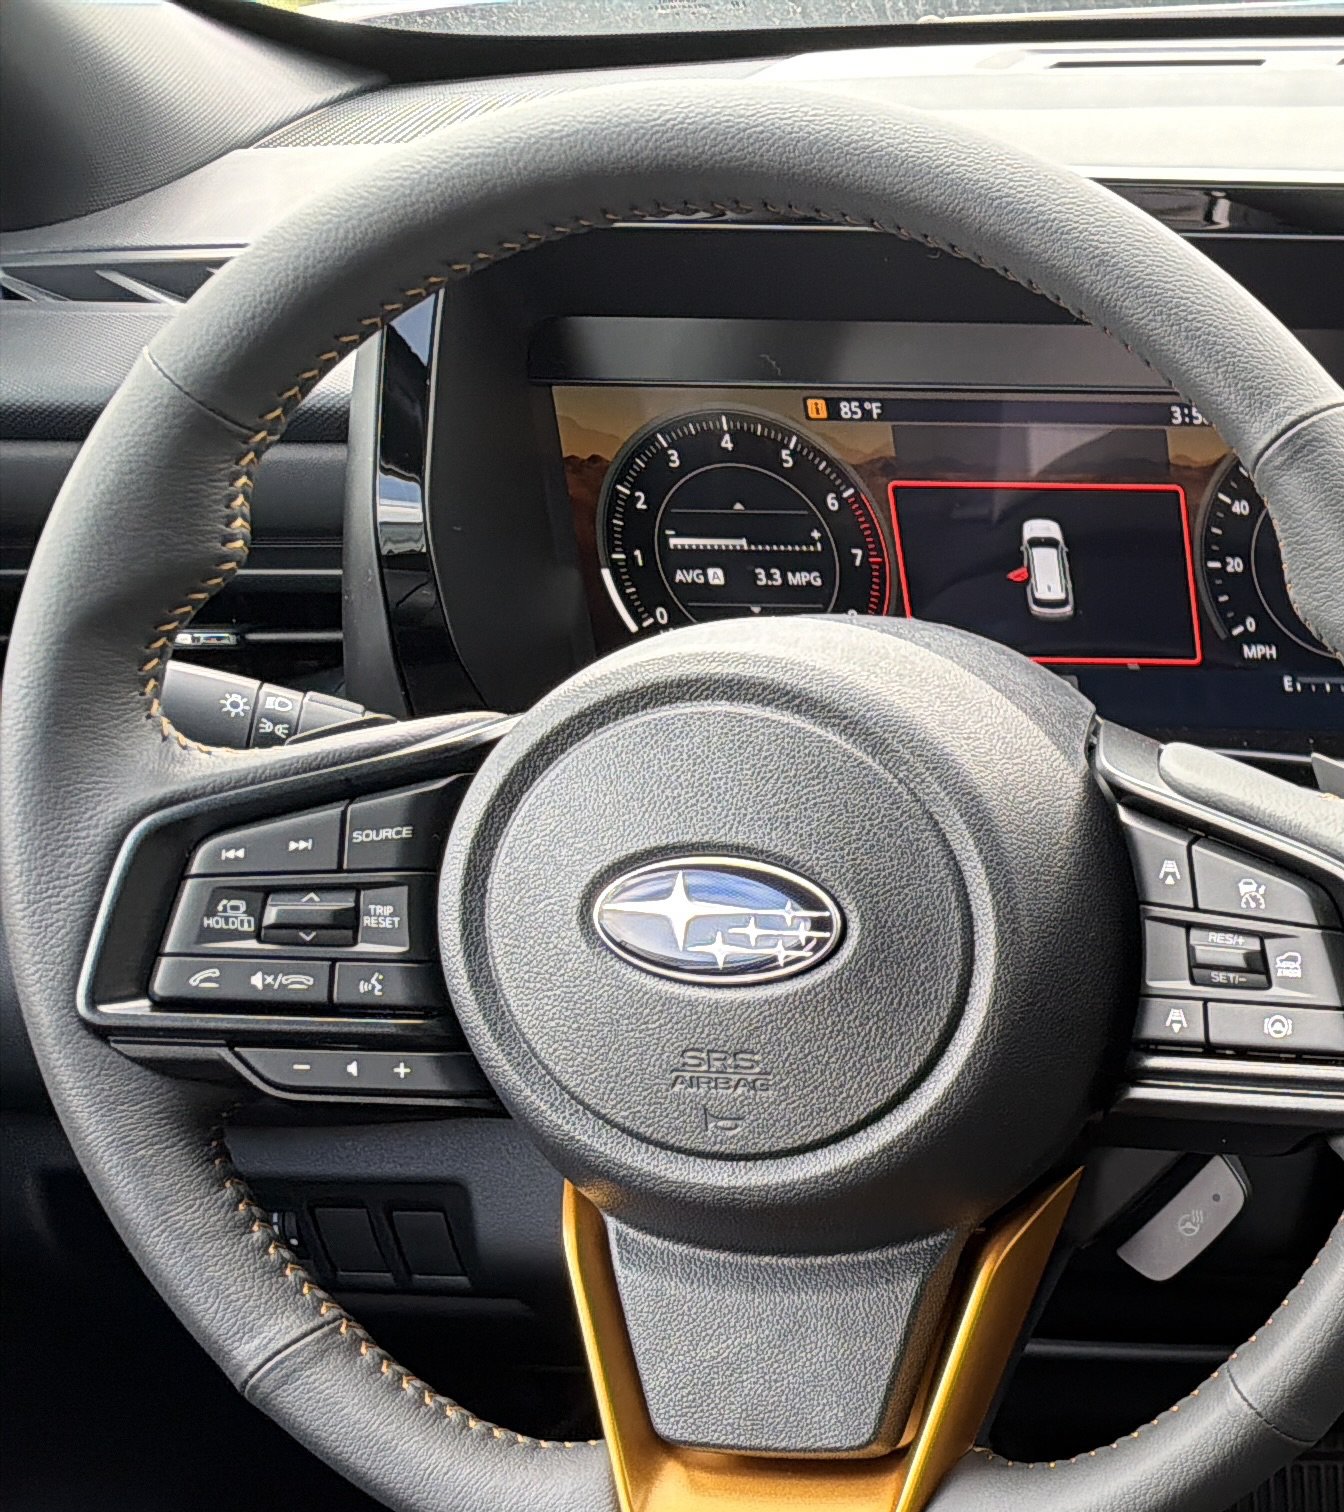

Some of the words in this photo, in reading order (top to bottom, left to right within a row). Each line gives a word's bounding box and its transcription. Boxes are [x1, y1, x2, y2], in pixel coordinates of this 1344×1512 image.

[721, 434, 734, 451] 4
[669, 450, 681, 469] 3
[781, 450, 794, 469] 5
[635, 491, 647, 510] 2
[826, 493, 839, 511] 6
[1232, 500, 1250, 516] 40
[634, 550, 643, 567] 1
[851, 549, 863, 567] 7
[1225, 557, 1244, 574] 20
[675, 569, 705, 585] AVG
[755, 569, 783, 586] 3.3
[788, 570, 822, 587] MPG
[656, 607, 668, 626] 0
[1245, 616, 1256, 633] 0
[1243, 645, 1277, 660] MPH
[1283, 675, 1294, 693] E
[352, 826, 413, 843] SOURCE
[369, 904, 394, 916] TRIP
[203, 916, 239, 929] HOLD
[363, 916, 401, 928] RESET
[679, 1050, 758, 1071] SRS
[669, 1074, 773, 1092] AIRBAG
